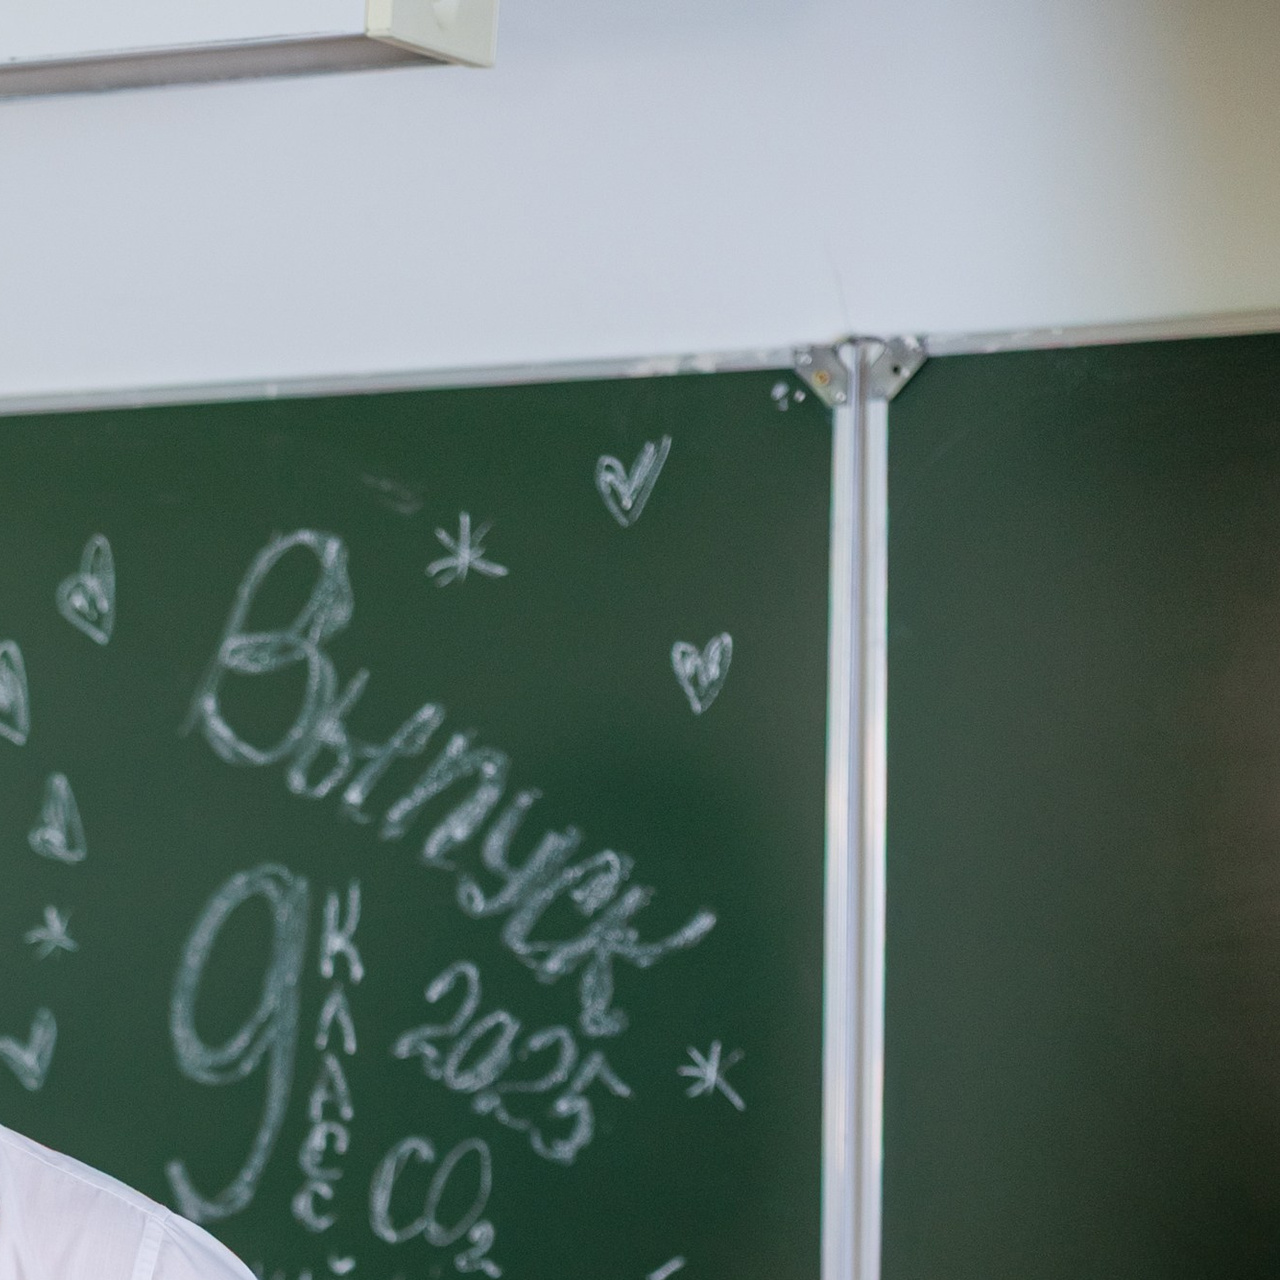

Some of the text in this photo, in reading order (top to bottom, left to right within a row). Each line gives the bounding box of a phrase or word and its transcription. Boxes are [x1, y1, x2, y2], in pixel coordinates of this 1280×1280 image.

[179, 527, 718, 1037] Выпуск
[166, 861, 312, 1223] 9
[392, 960, 635, 1165] 2025
